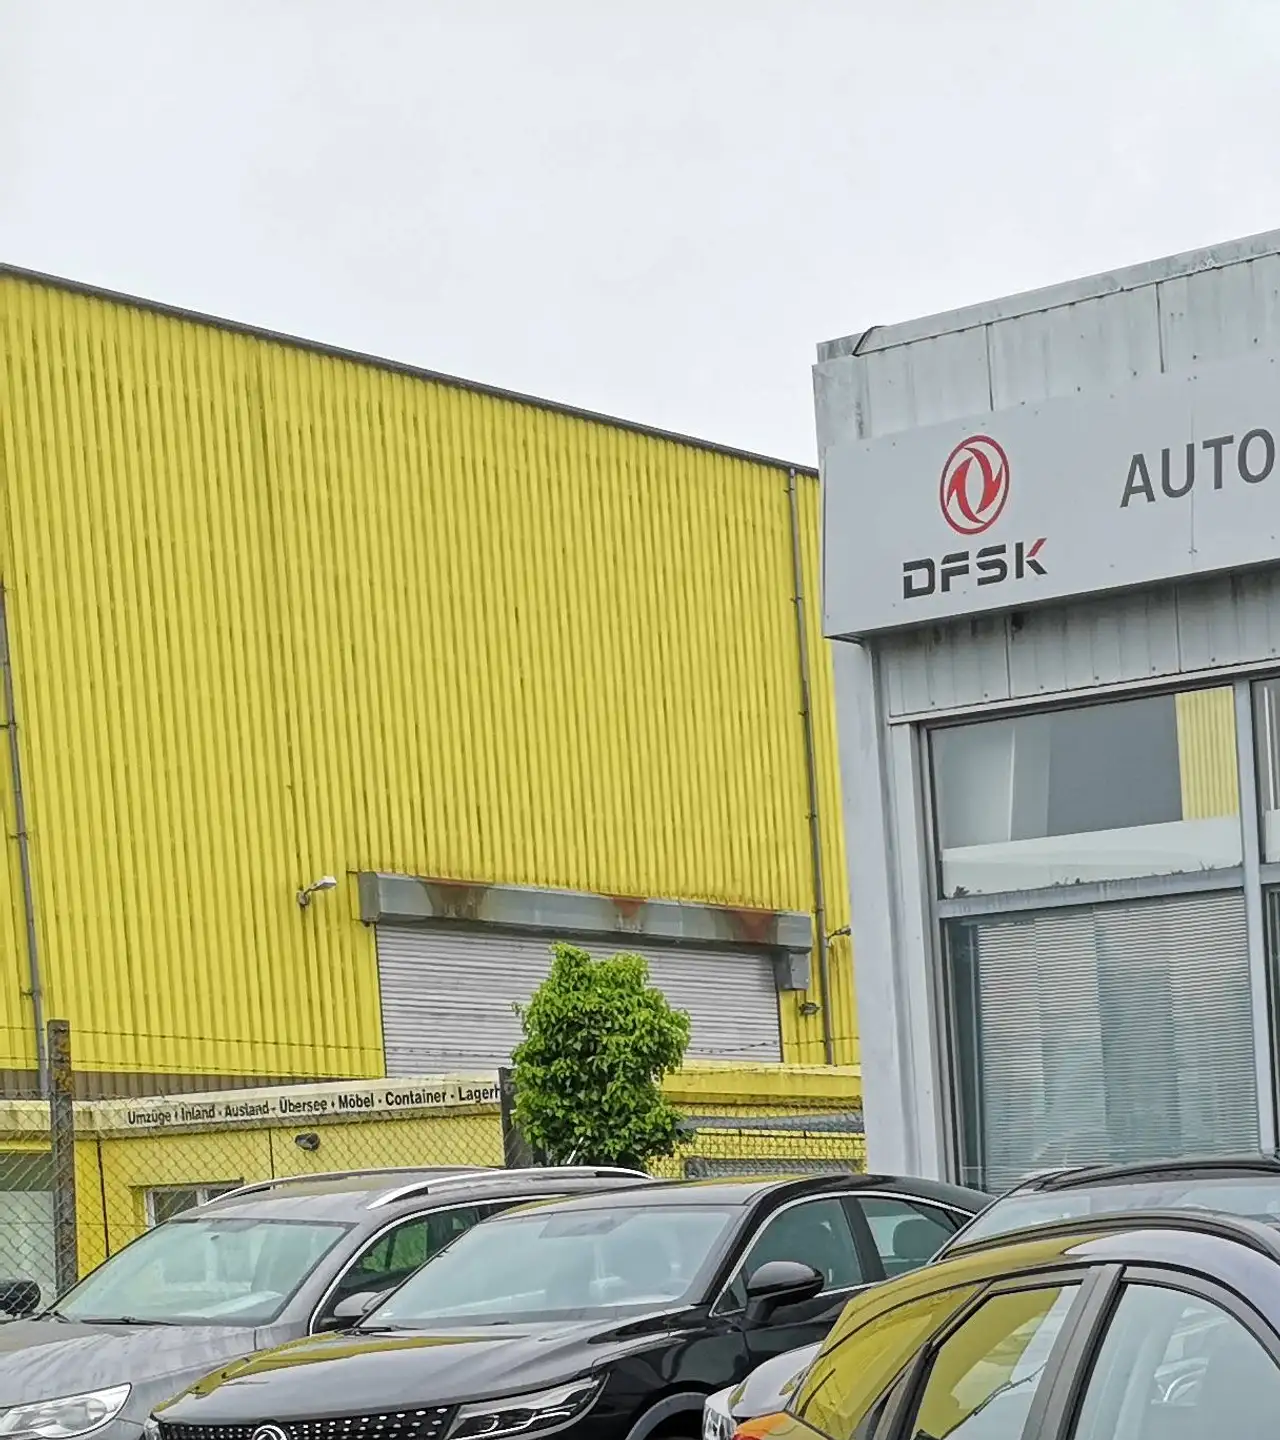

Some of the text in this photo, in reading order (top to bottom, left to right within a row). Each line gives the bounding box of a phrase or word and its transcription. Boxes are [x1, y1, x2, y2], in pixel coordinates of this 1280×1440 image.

[1119, 426, 1276, 508] AUTO
[902, 537, 1049, 600] DFSK
[279, 1096, 328, 1113] Übersee
[338, 1093, 374, 1109] Möbel
[385, 1089, 447, 1106] Container
